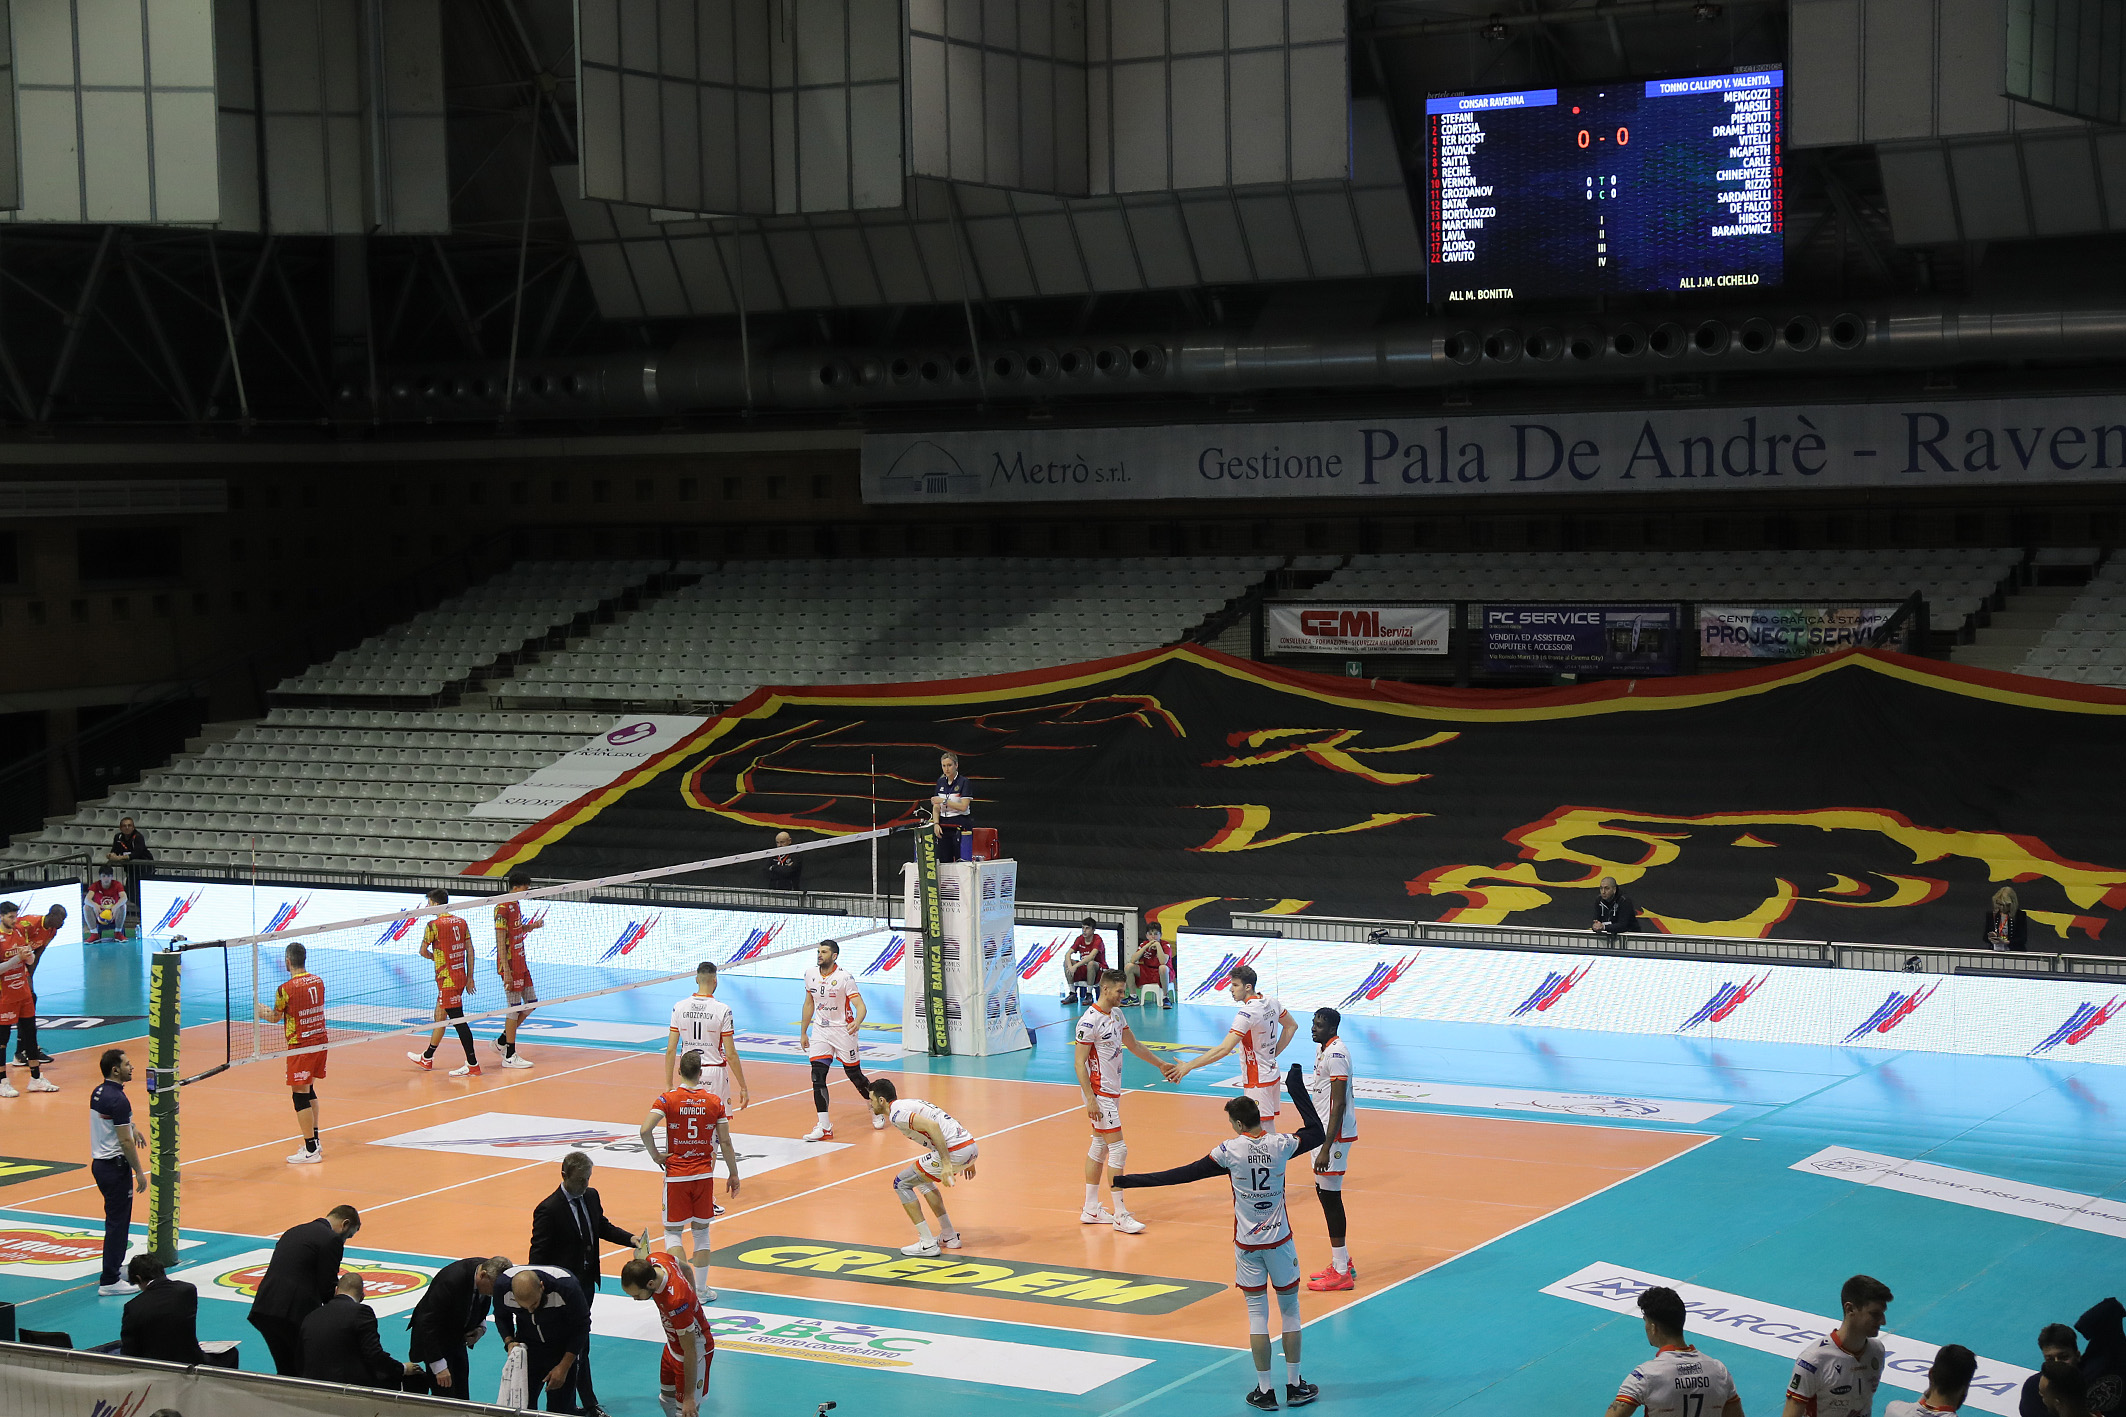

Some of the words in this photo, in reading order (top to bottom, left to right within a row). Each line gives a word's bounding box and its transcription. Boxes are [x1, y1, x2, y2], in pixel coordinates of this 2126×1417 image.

[1660, 82, 1688, 93] TONNO
[1690, 79, 1722, 91] CALLIPO
[1723, 78, 1731, 88] V.
[1733, 75, 1770, 87] VALENTIA
[1724, 89, 1770, 102] MENGOZZI
[1774, 89, 1779, 98] 1
[1459, 98, 1488, 109] CONSAR
[1490, 96, 1524, 107] RAVENNA
[1735, 100, 1770, 113] MARSILI
[1774, 100, 1780, 109] 3
[1432, 116, 1436, 124] 1
[1441, 112, 1473, 124] STEFANI
[1731, 111, 1770, 124] PIEROTTI
[1774, 112, 1780, 120] 4
[1432, 126, 1437, 136] 2
[1441, 123, 1480, 135] CORTESIA
[1713, 124, 1745, 136] DRAME
[1747, 122, 1771, 134] NETO
[1775, 122, 1779, 132] 5
[1432, 137, 1438, 146] 4
[1441, 135, 1457, 146] TER
[1458, 133, 1486, 144] HORST
[1577, 130, 1590, 148] 0
[1616, 127, 1629, 146] 0
[1739, 134, 1770, 146] VITELLI
[1774, 134, 1780, 143] 6
[1432, 148, 1437, 157] 5
[1442, 144, 1476, 156] KOVACIC
[1730, 145, 1770, 158] NGAPETH
[1774, 145, 1780, 154] 8
[1432, 158, 1437, 167] 8
[1442, 156, 1468, 167] SAITTA
[1743, 156, 1771, 168] CARLE
[1774, 156, 1780, 165] 9
[1432, 169, 1437, 178] 9
[1442, 166, 1471, 178] RECINE
[1716, 167, 1771, 181] CHINENYEZE
[1773, 167, 1783, 177] 10
[1431, 180, 1440, 188] 10
[1442, 177, 1476, 188] VERNON
[1586, 176, 1592, 187] 0
[1599, 176, 1605, 185] T
[1610, 174, 1617, 185] 0
[1745, 179, 1771, 190] RIZZO
[1773, 178, 1782, 188] 11
[1431, 190, 1440, 199] 11
[1442, 186, 1493, 199] GROZDANOV
[1586, 190, 1592, 200] 0
[1599, 190, 1605, 199] C
[1611, 188, 1617, 199] 0
[1718, 189, 1771, 203] SARDANELLI
[1773, 189, 1783, 199] 12
[1431, 201, 1440, 210] 12
[1442, 198, 1468, 209] BATAK
[1730, 202, 1742, 213] DE
[1744, 201, 1771, 212] FALCO
[1773, 201, 1783, 211] 13
[1431, 211, 1440, 220] 13
[1442, 207, 1496, 220] BORTOLOZZO
[1738, 212, 1771, 224] HIRSCH
[1773, 212, 1783, 222] 15
[1431, 222, 1440, 230] 14
[1442, 219, 1483, 230] MARCHINI
[1712, 223, 1771, 236] BARANOWICZ
[1773, 223, 1783, 232] 17
[1431, 232, 1440, 241] 15
[1442, 230, 1466, 241] LAVIA
[1431, 243, 1440, 252] 17
[1442, 240, 1475, 252] ALONSO
[1598, 243, 1606, 253] III
[1431, 254, 1440, 263] 22
[1442, 251, 1475, 262] CAVUTO
[1598, 257, 1606, 267] IV
[1680, 278, 1695, 288] ALL
[1697, 277, 1715, 288] J.M.
[1717, 274, 1759, 286] CICHELLO
[1449, 291, 1464, 300] ALL
[1466, 290, 1476, 300] M.
[1478, 289, 1513, 299] BONITTA
[990, 450, 1087, 488] Metrò
[1094, 460, 1132, 484] s.r.l.
[1199, 445, 1343, 482] Gestione
[1358, 425, 1490, 486] Pala
[1509, 423, 1601, 483] De
[1619, 413, 1828, 480] Andrè
[1300, 610, 1379, 638] CEMI
[1380, 626, 1413, 638] Servizi
[1489, 612, 1514, 624] PC
[1520, 612, 1600, 625] SERVICE
[1718, 614, 1768, 624] CENTRO
[1771, 615, 1824, 624] GRAFICA
[1828, 616, 1835, 624] &
[1838, 616, 1888, 624] STAMPA
[1706, 626, 1804, 645] PROJECT
[925, 834, 936, 880] BANCA
[926, 886, 941, 938] CREDEM
[452, 926, 461, 941] 13
[931, 945, 942, 990] BANCA
[149, 965, 163, 1028] BANCA
[308, 986, 318, 1004] 17
[934, 997, 947, 1047] CREDEM
[694, 1022, 701, 1040] 11
[1270, 1020, 1275, 1039] 2
[680, 1107, 706, 1115] KOVACIC
[688, 1118, 698, 1139] 5
[150, 1116, 160, 1176] BANCA
[1248, 1155, 1272, 1164] BATAK
[1251, 1168, 1270, 1191] 12
[148, 1184, 159, 1253] CREDEM
[738, 1246, 1189, 1305] CREDEM
[762, 1324, 932, 1352] BCC
[747, 1335, 808, 1347] CREDITO
[806, 1342, 901, 1359] COOPERATIVO
[1675, 1377, 1710, 1389] ALONSO
[1683, 1394, 1704, 1417] 17
